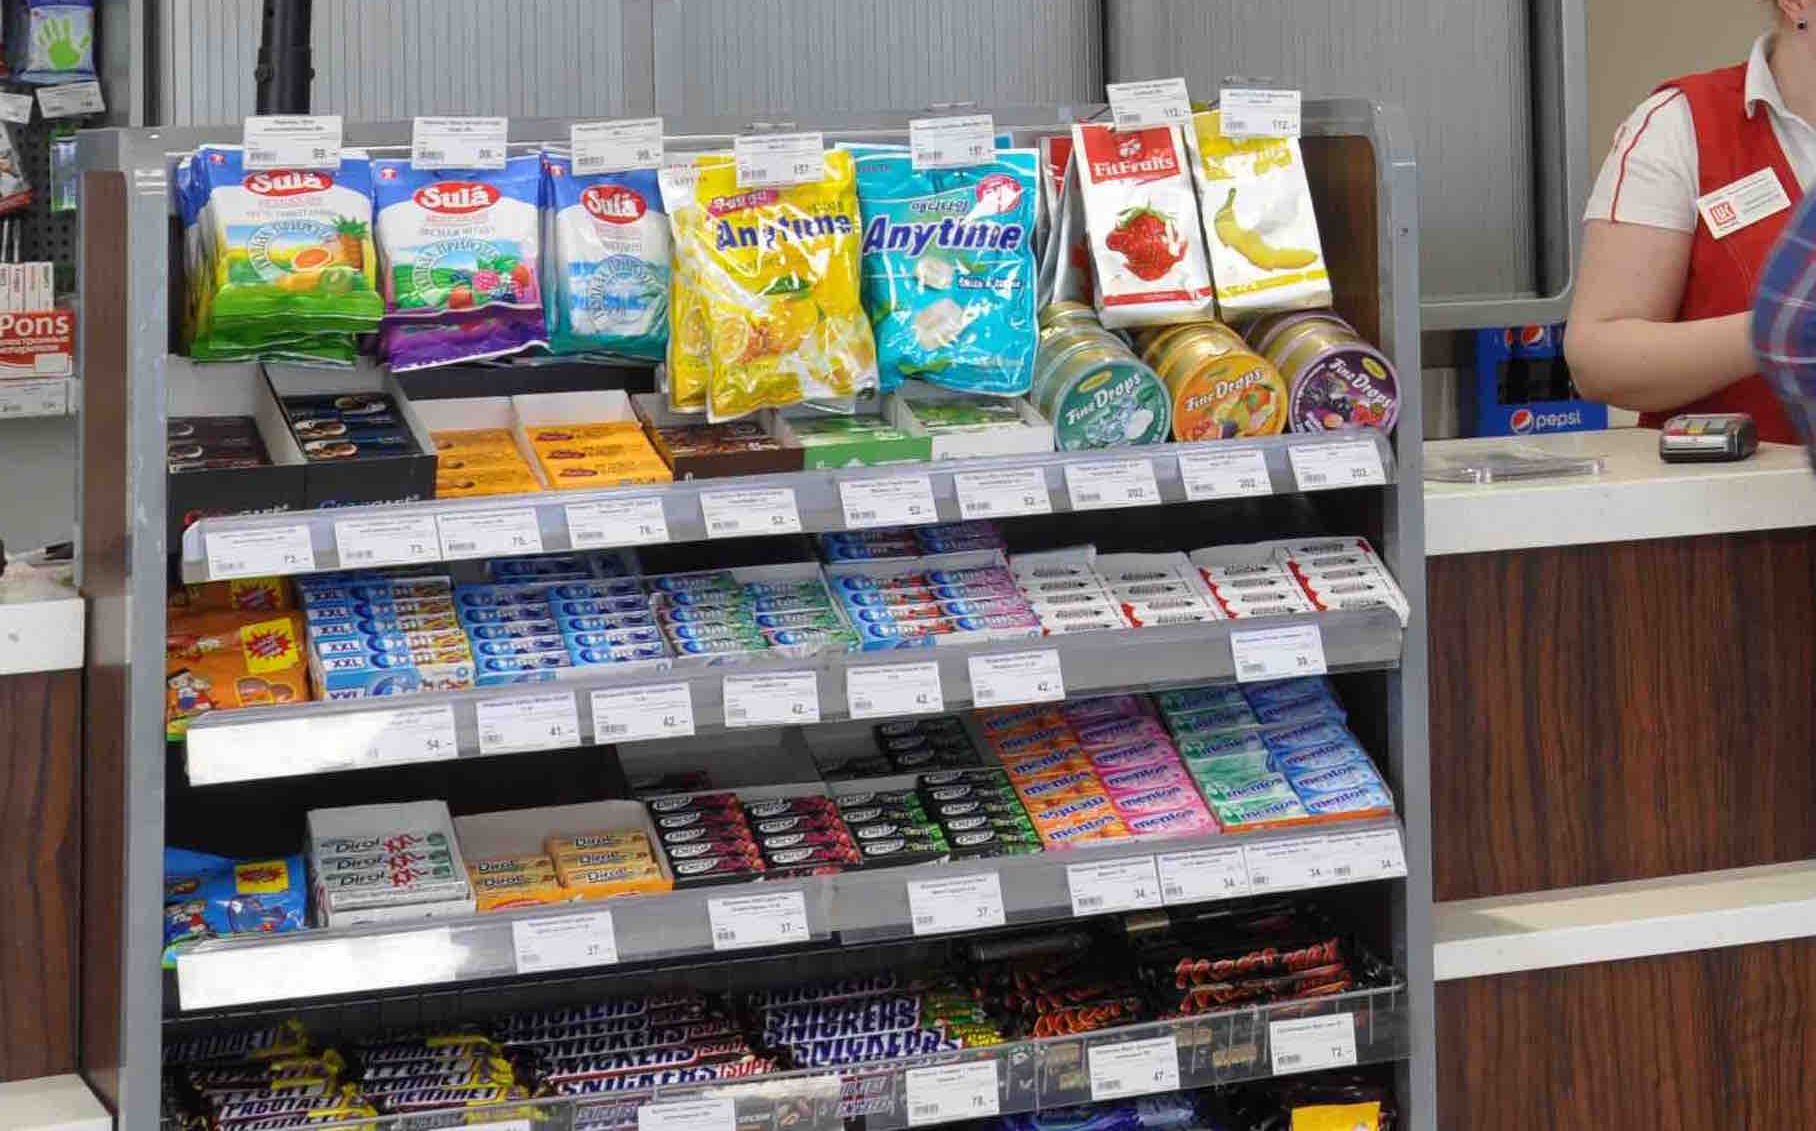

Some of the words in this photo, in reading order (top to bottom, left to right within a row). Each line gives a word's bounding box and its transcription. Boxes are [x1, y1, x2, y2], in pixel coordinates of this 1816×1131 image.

[862, 214, 1024, 258] Anytime
[1096, 372, 1141, 408] Drops
[1214, 368, 1264, 400] Drops
[1351, 376, 1393, 409] Drops
[1535, 410, 1582, 432] pepsi
[1286, 741, 1346, 766] mentos
[1023, 770, 1093, 796] mentos
[1108, 763, 1169, 786] mentos
[1299, 765, 1357, 788] mentos
[1119, 785, 1182, 807] mentos
[1227, 776, 1285, 799] mentos
[1310, 787, 1371, 810] mentos
[1133, 809, 1196, 831] mentos
[1241, 799, 1299, 821] mentos
[1048, 815, 1117, 841] mentos
[334, 837, 382, 854] Dirol
[335, 855, 384, 871] Dirol
[338, 871, 387, 888] Dirol
